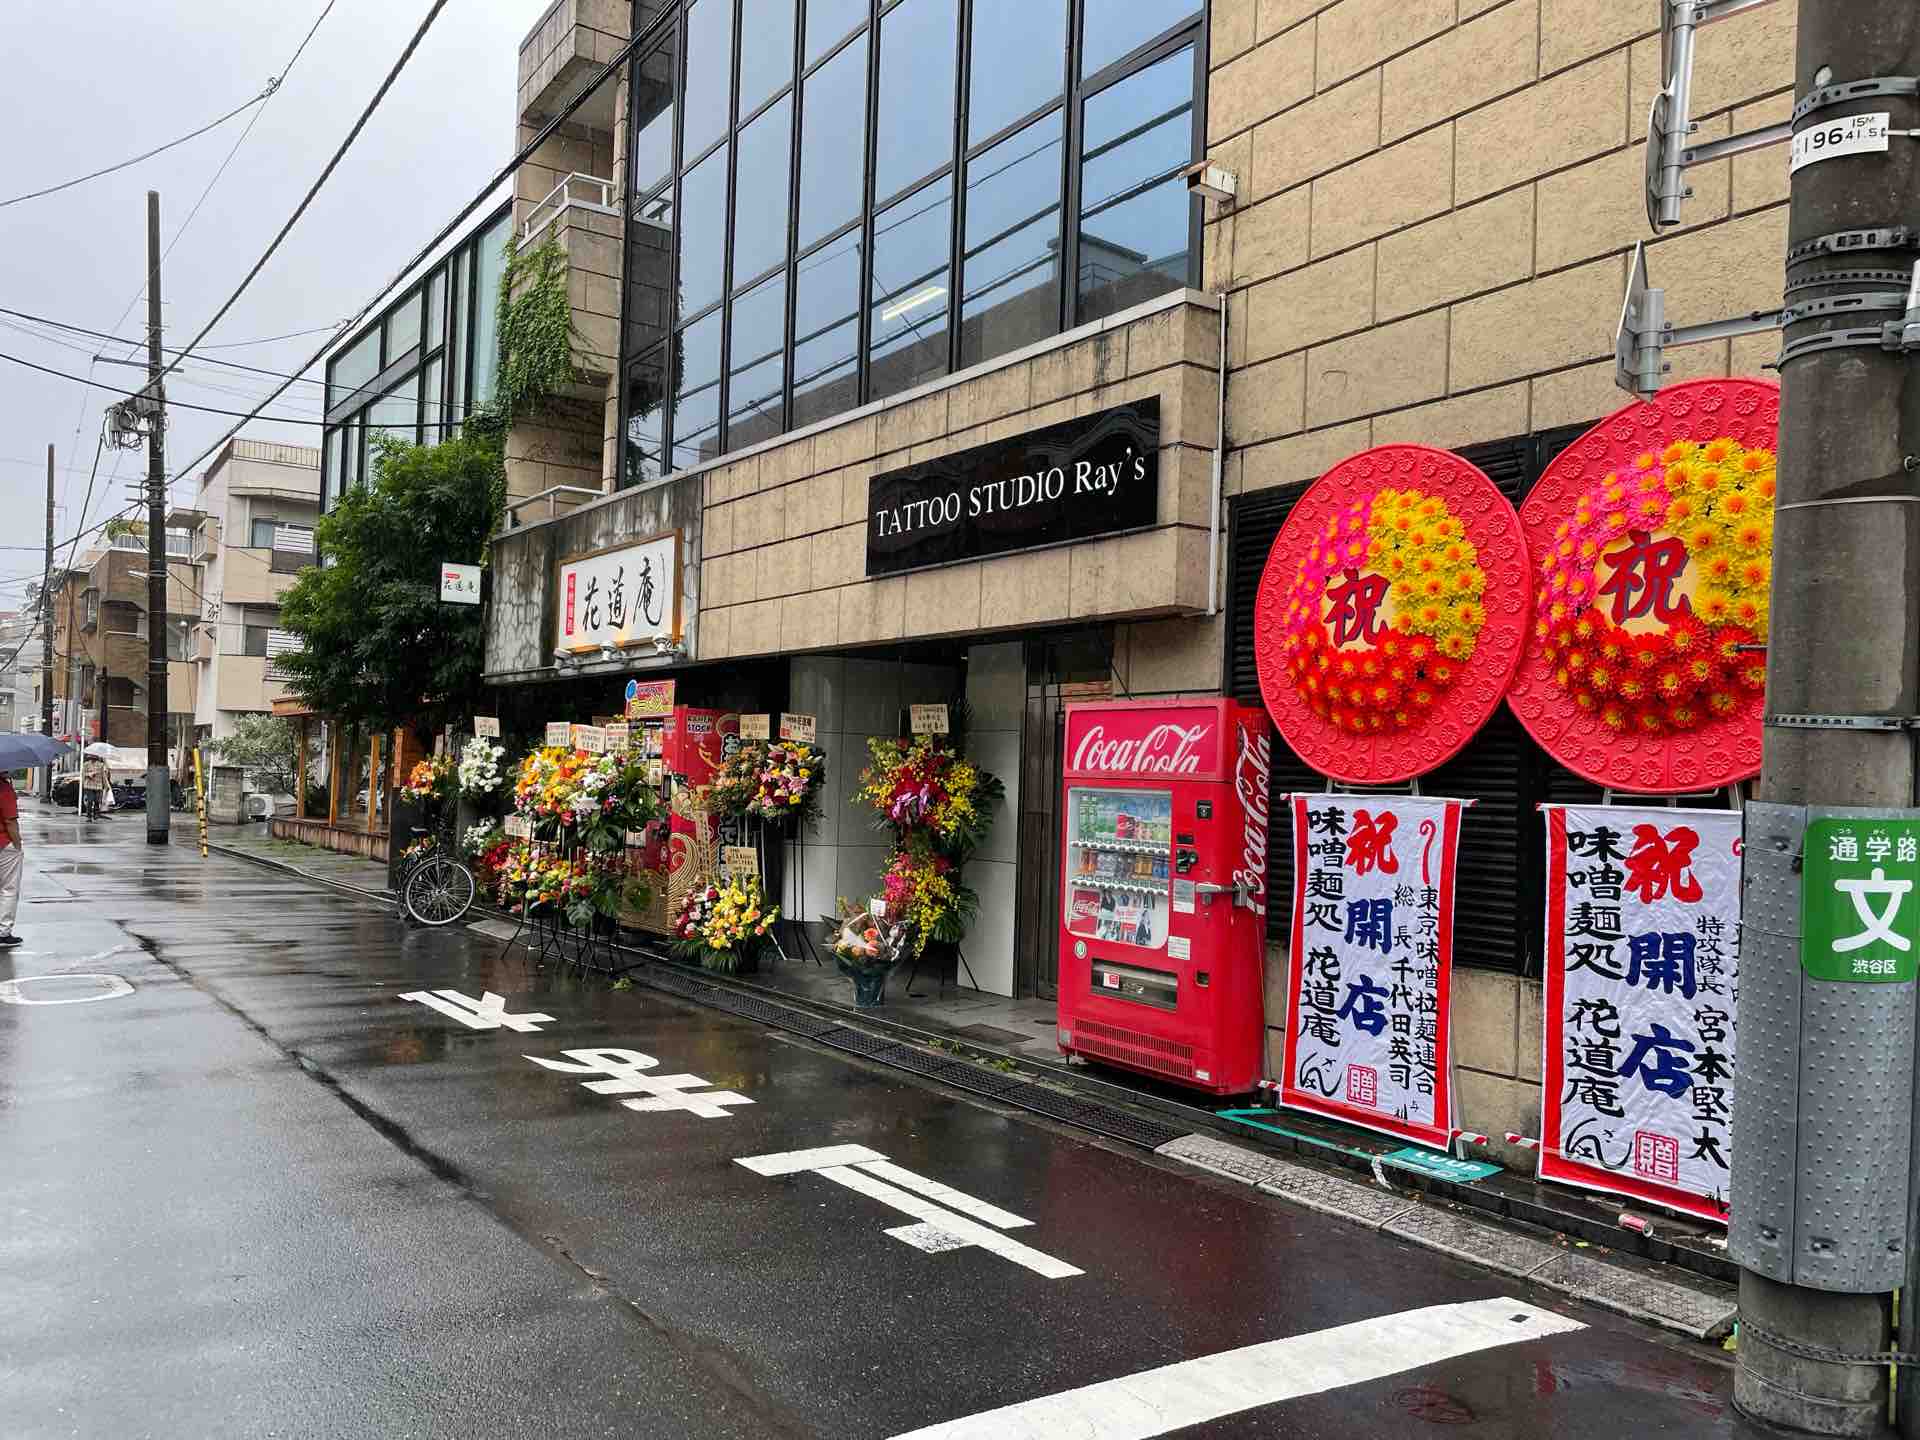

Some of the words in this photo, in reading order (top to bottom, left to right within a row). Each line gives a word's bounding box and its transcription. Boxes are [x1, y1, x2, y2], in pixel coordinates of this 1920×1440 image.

[876, 492, 961, 537] TATTOO
[968, 467, 1065, 518] STUDIO
[1073, 446, 1145, 497] Ray's
[582, 551, 665, 632] 花道庵
[1321, 566, 1393, 650] 祝
[1601, 529, 1697, 627] 祝
[1073, 724, 1214, 773] Coca-Cola
[1304, 806, 1348, 933] 味噌麺処
[1345, 808, 1400, 877] 祝
[1623, 823, 1704, 905] 祝
[1829, 835, 1917, 862] 通学路
[1563, 825, 1627, 981] 味噌麺処
[1831, 867, 1913, 952] 文
[1334, 897, 1393, 1038] 開店
[1413, 886, 1440, 1096] 東京味噌拉麺連合
[1696, 915, 1726, 996] 特攻隊長
[1851, 959, 1897, 974] 渋谷区
[1618, 931, 1698, 1100] 開店
